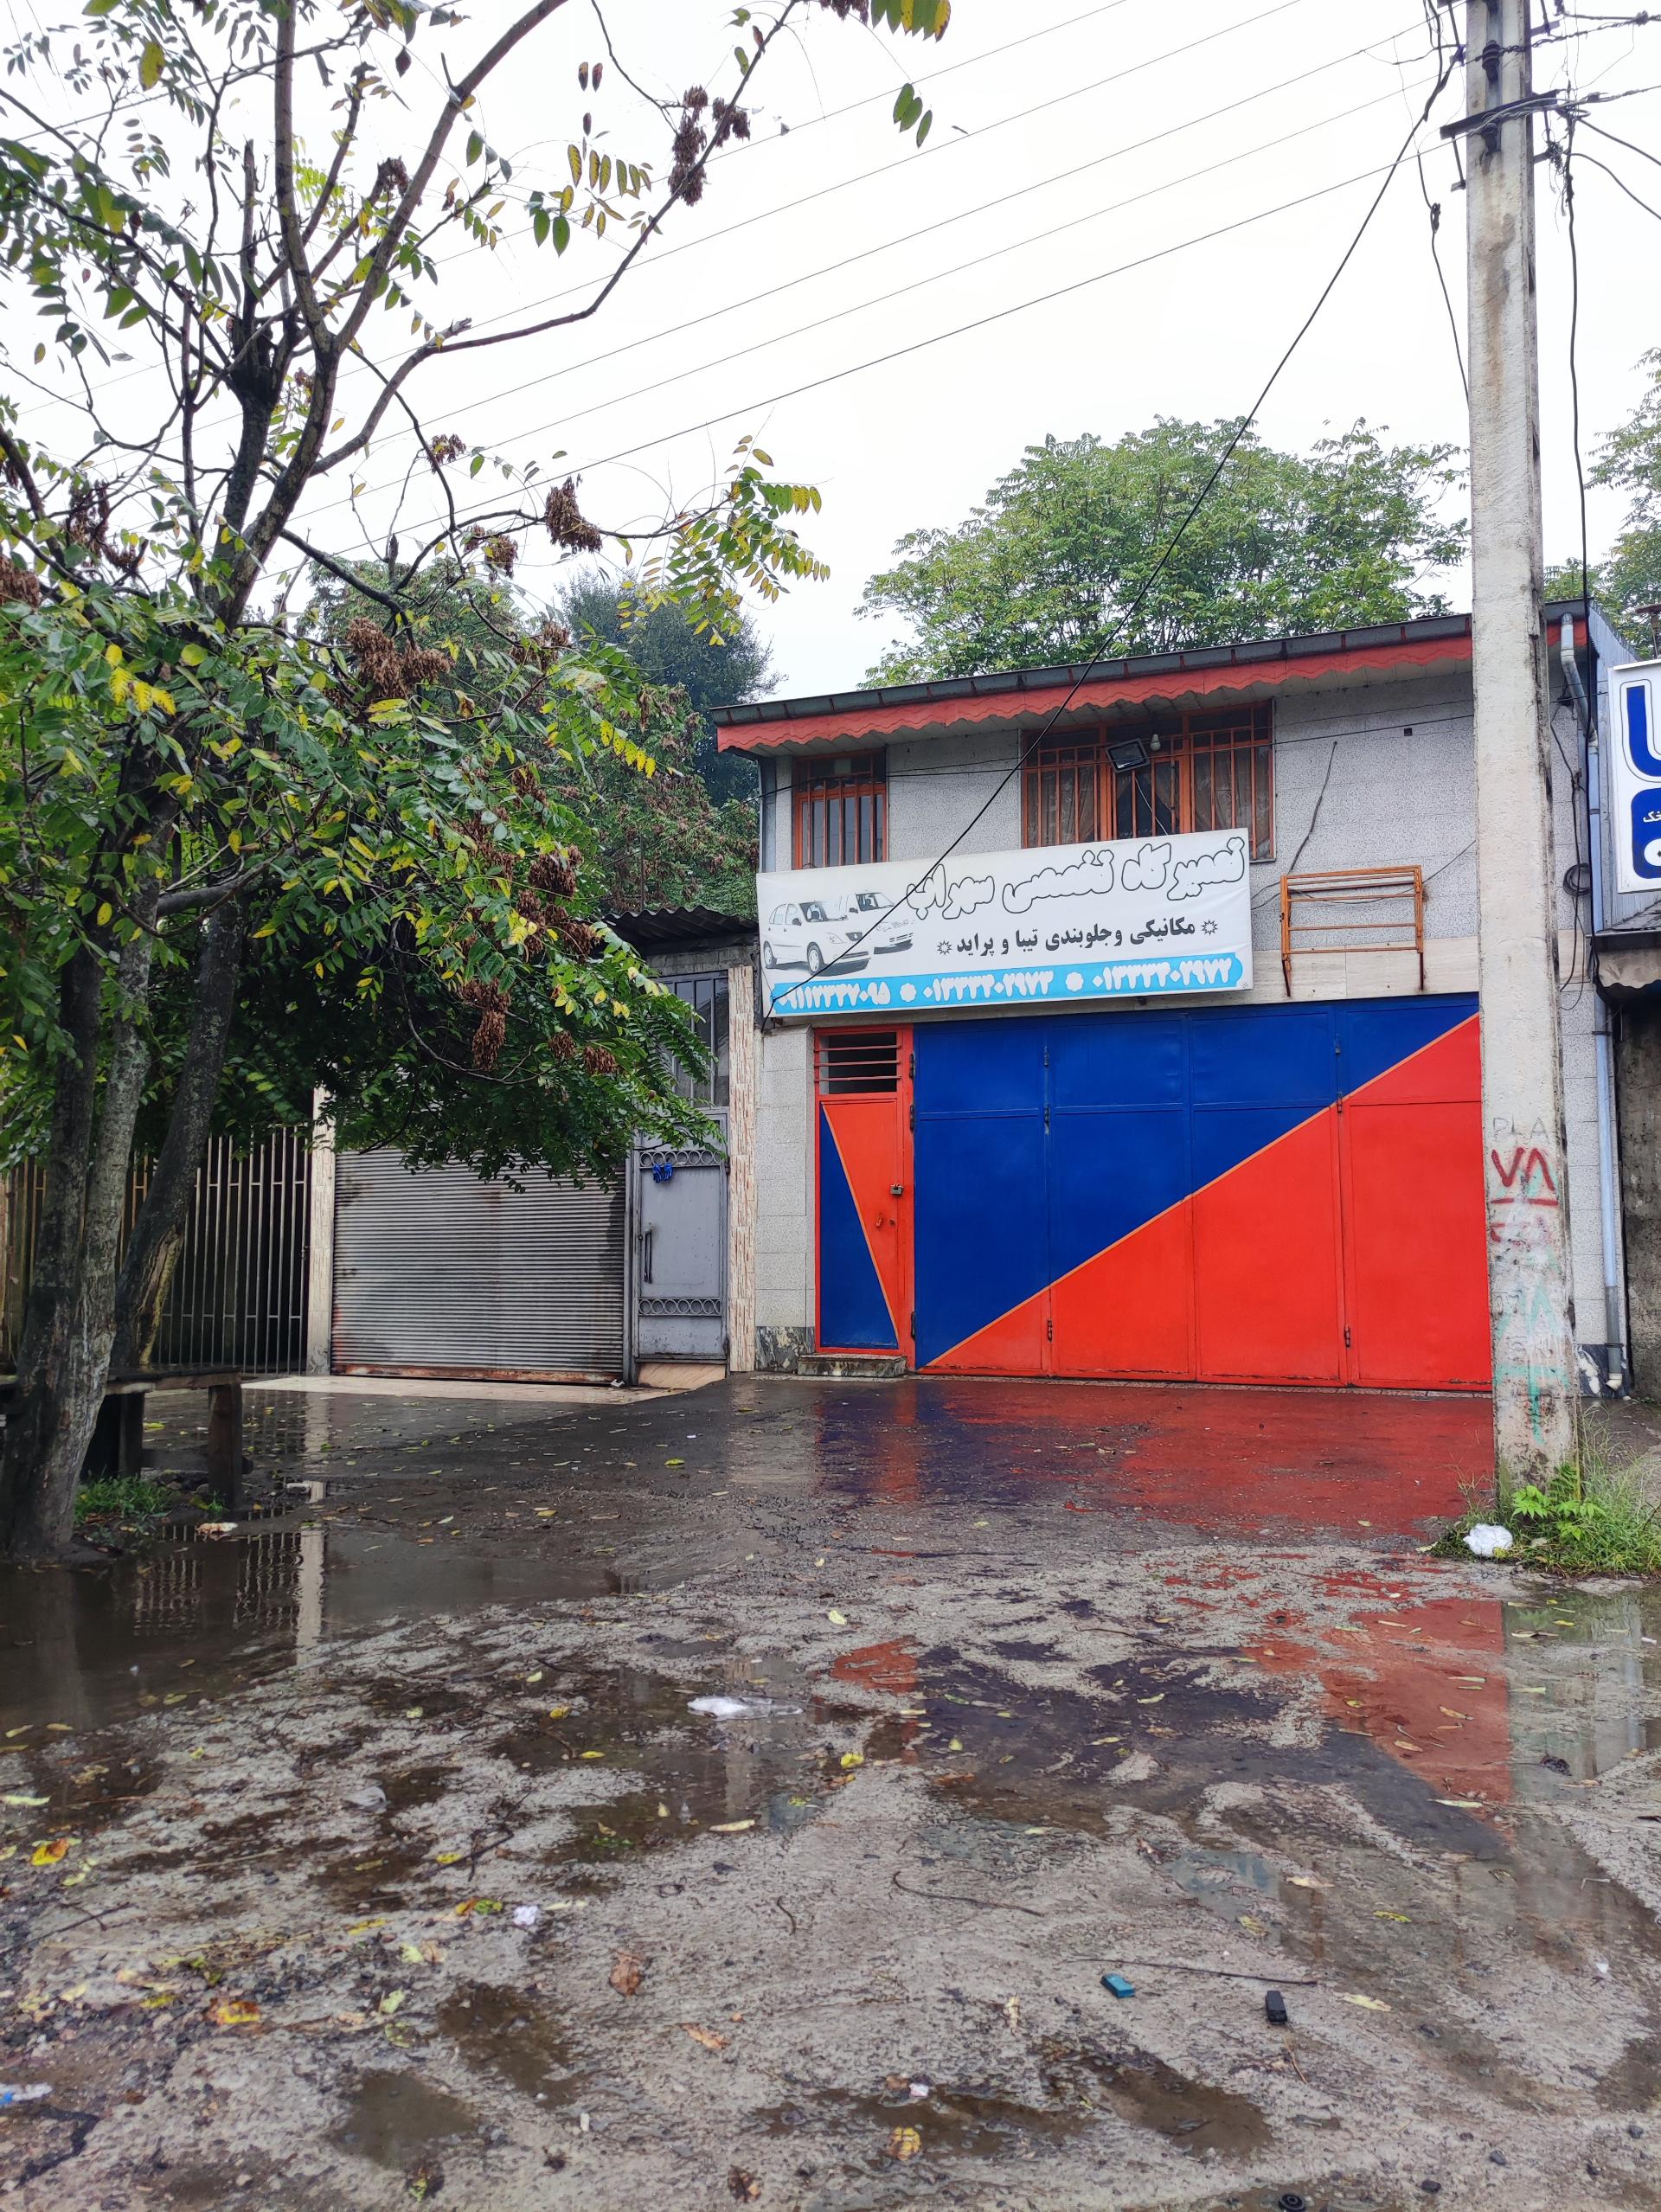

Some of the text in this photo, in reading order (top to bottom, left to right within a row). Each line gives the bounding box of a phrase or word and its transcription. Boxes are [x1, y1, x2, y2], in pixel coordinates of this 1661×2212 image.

[1016, 929, 1038, 952] تیبا
[1130, 917, 1196, 945] مکانیکی
[957, 933, 994, 957] پراید
[1002, 939, 1009, 955] و
